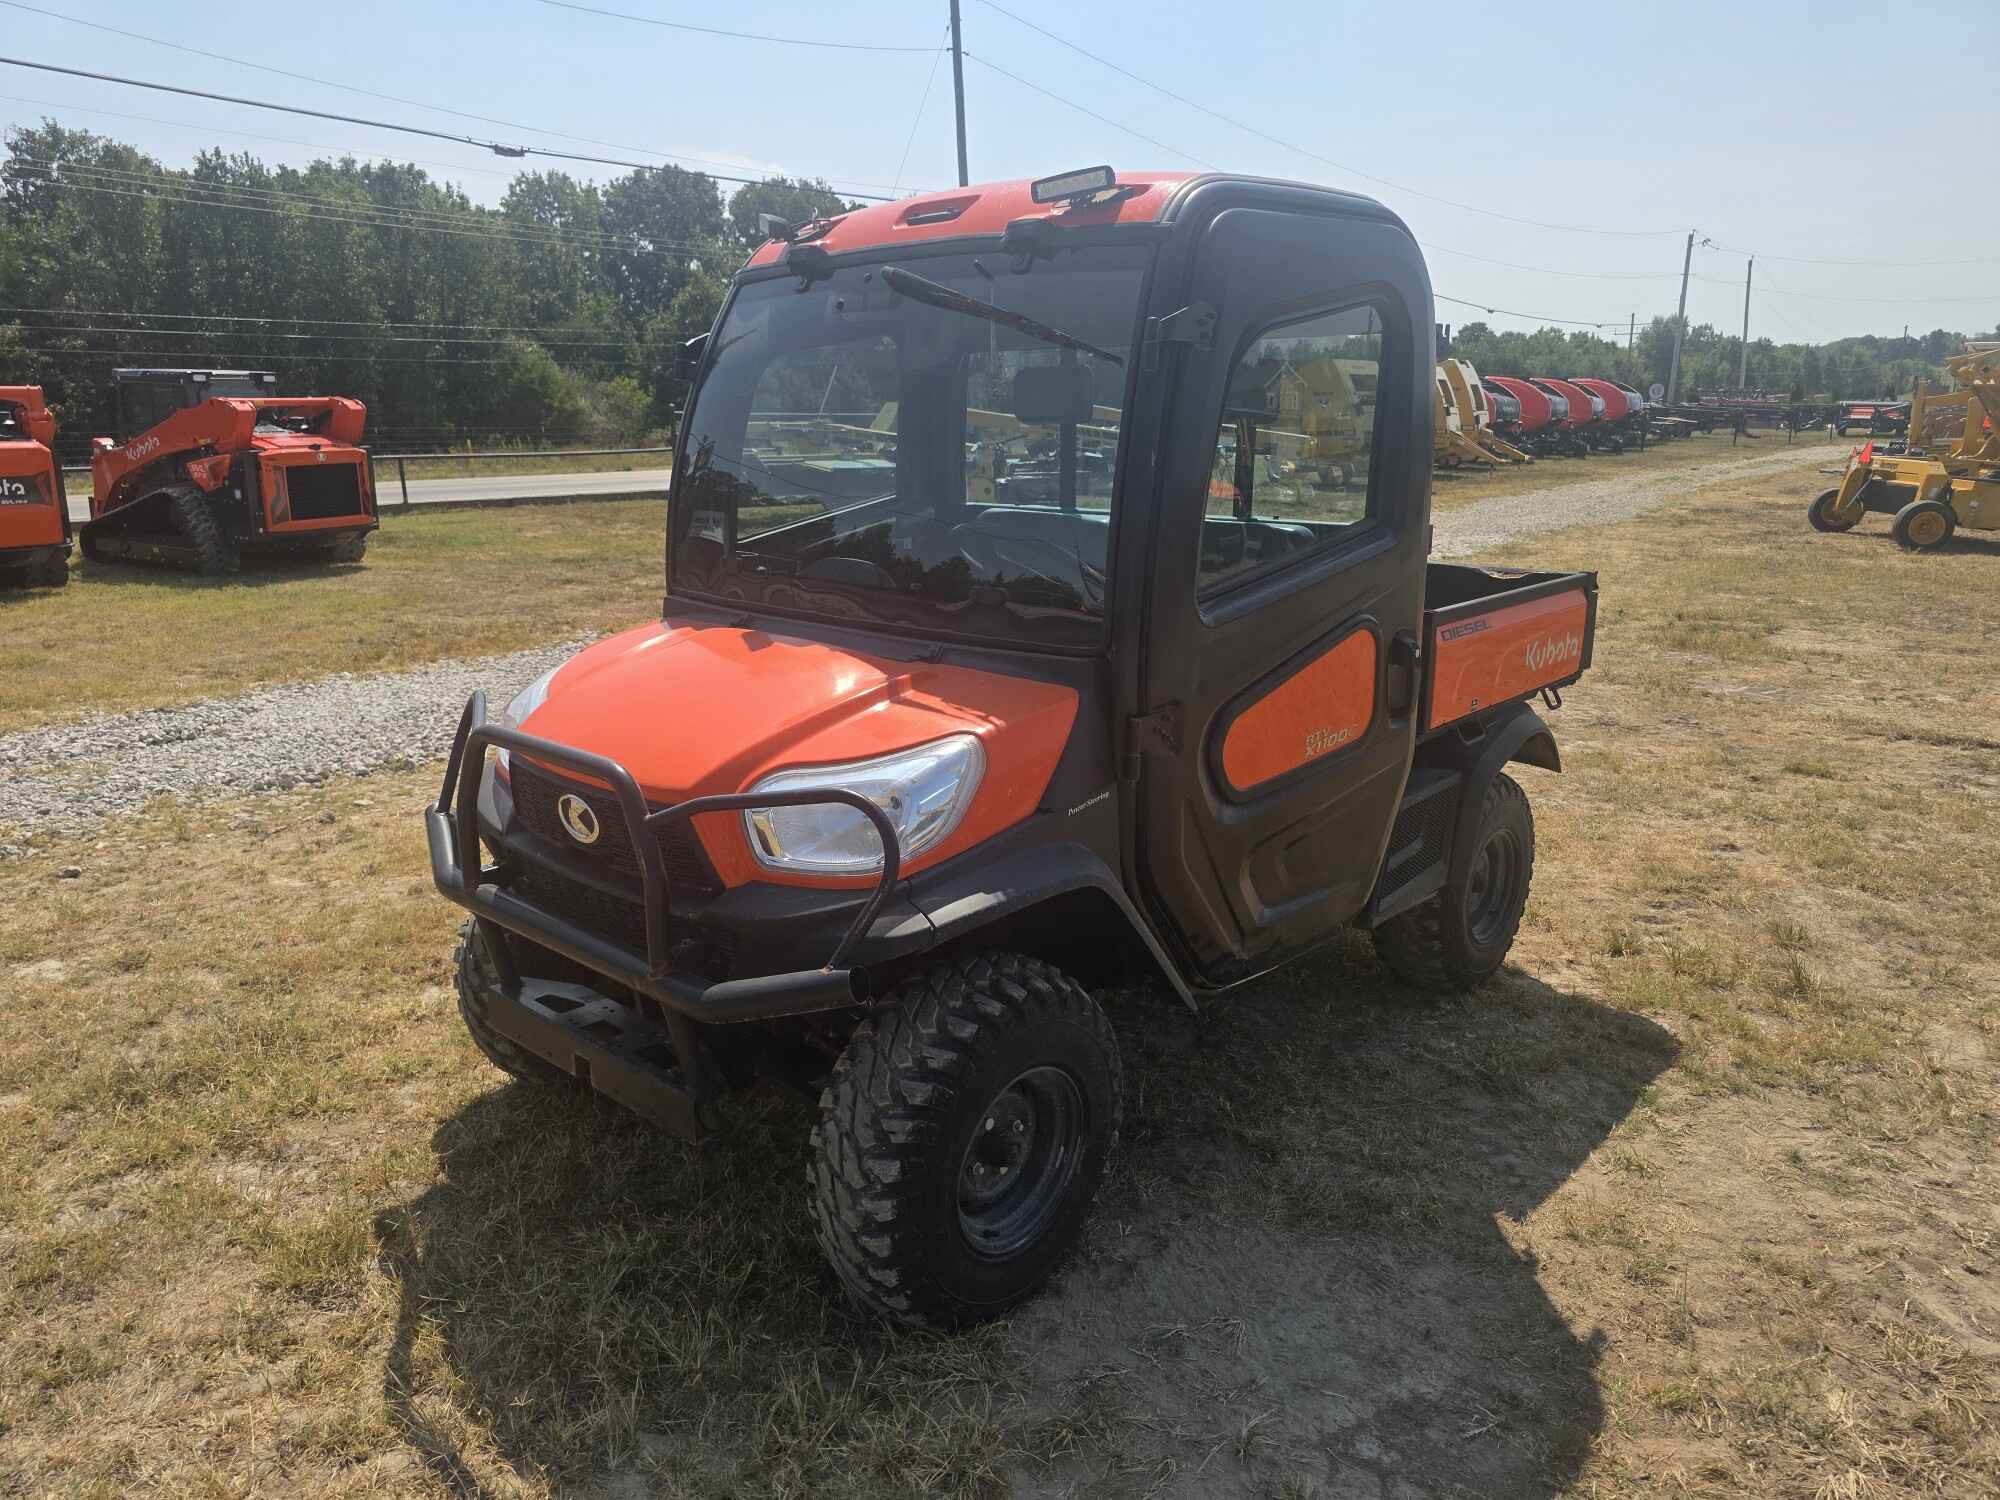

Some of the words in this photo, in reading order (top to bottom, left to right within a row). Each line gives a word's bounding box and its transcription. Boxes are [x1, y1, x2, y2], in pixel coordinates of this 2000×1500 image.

[127, 437, 160, 461] Kubota
[0, 479, 25, 495] ta
[1440, 620, 1492, 642] DIESEL
[1525, 632, 1578, 672] Kubota
